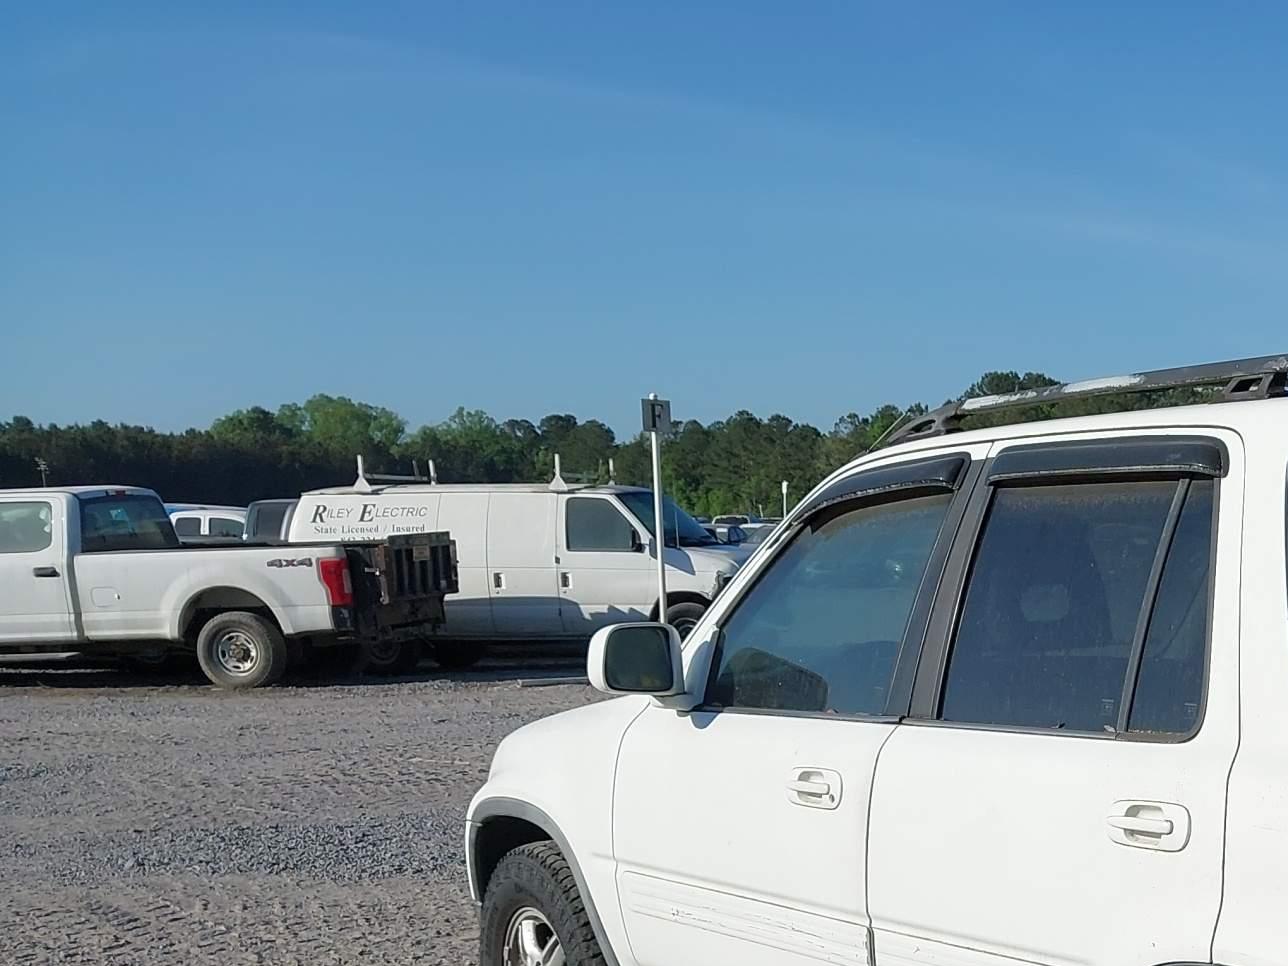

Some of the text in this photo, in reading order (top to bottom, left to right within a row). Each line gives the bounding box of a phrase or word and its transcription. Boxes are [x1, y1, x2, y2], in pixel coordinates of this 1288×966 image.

[650, 403, 664, 429] F
[310, 503, 428, 523] RILEY ELECTRIC
[314, 525, 338, 534] State
[341, 524, 379, 534] Licensed
[391, 523, 425, 533] Insured
